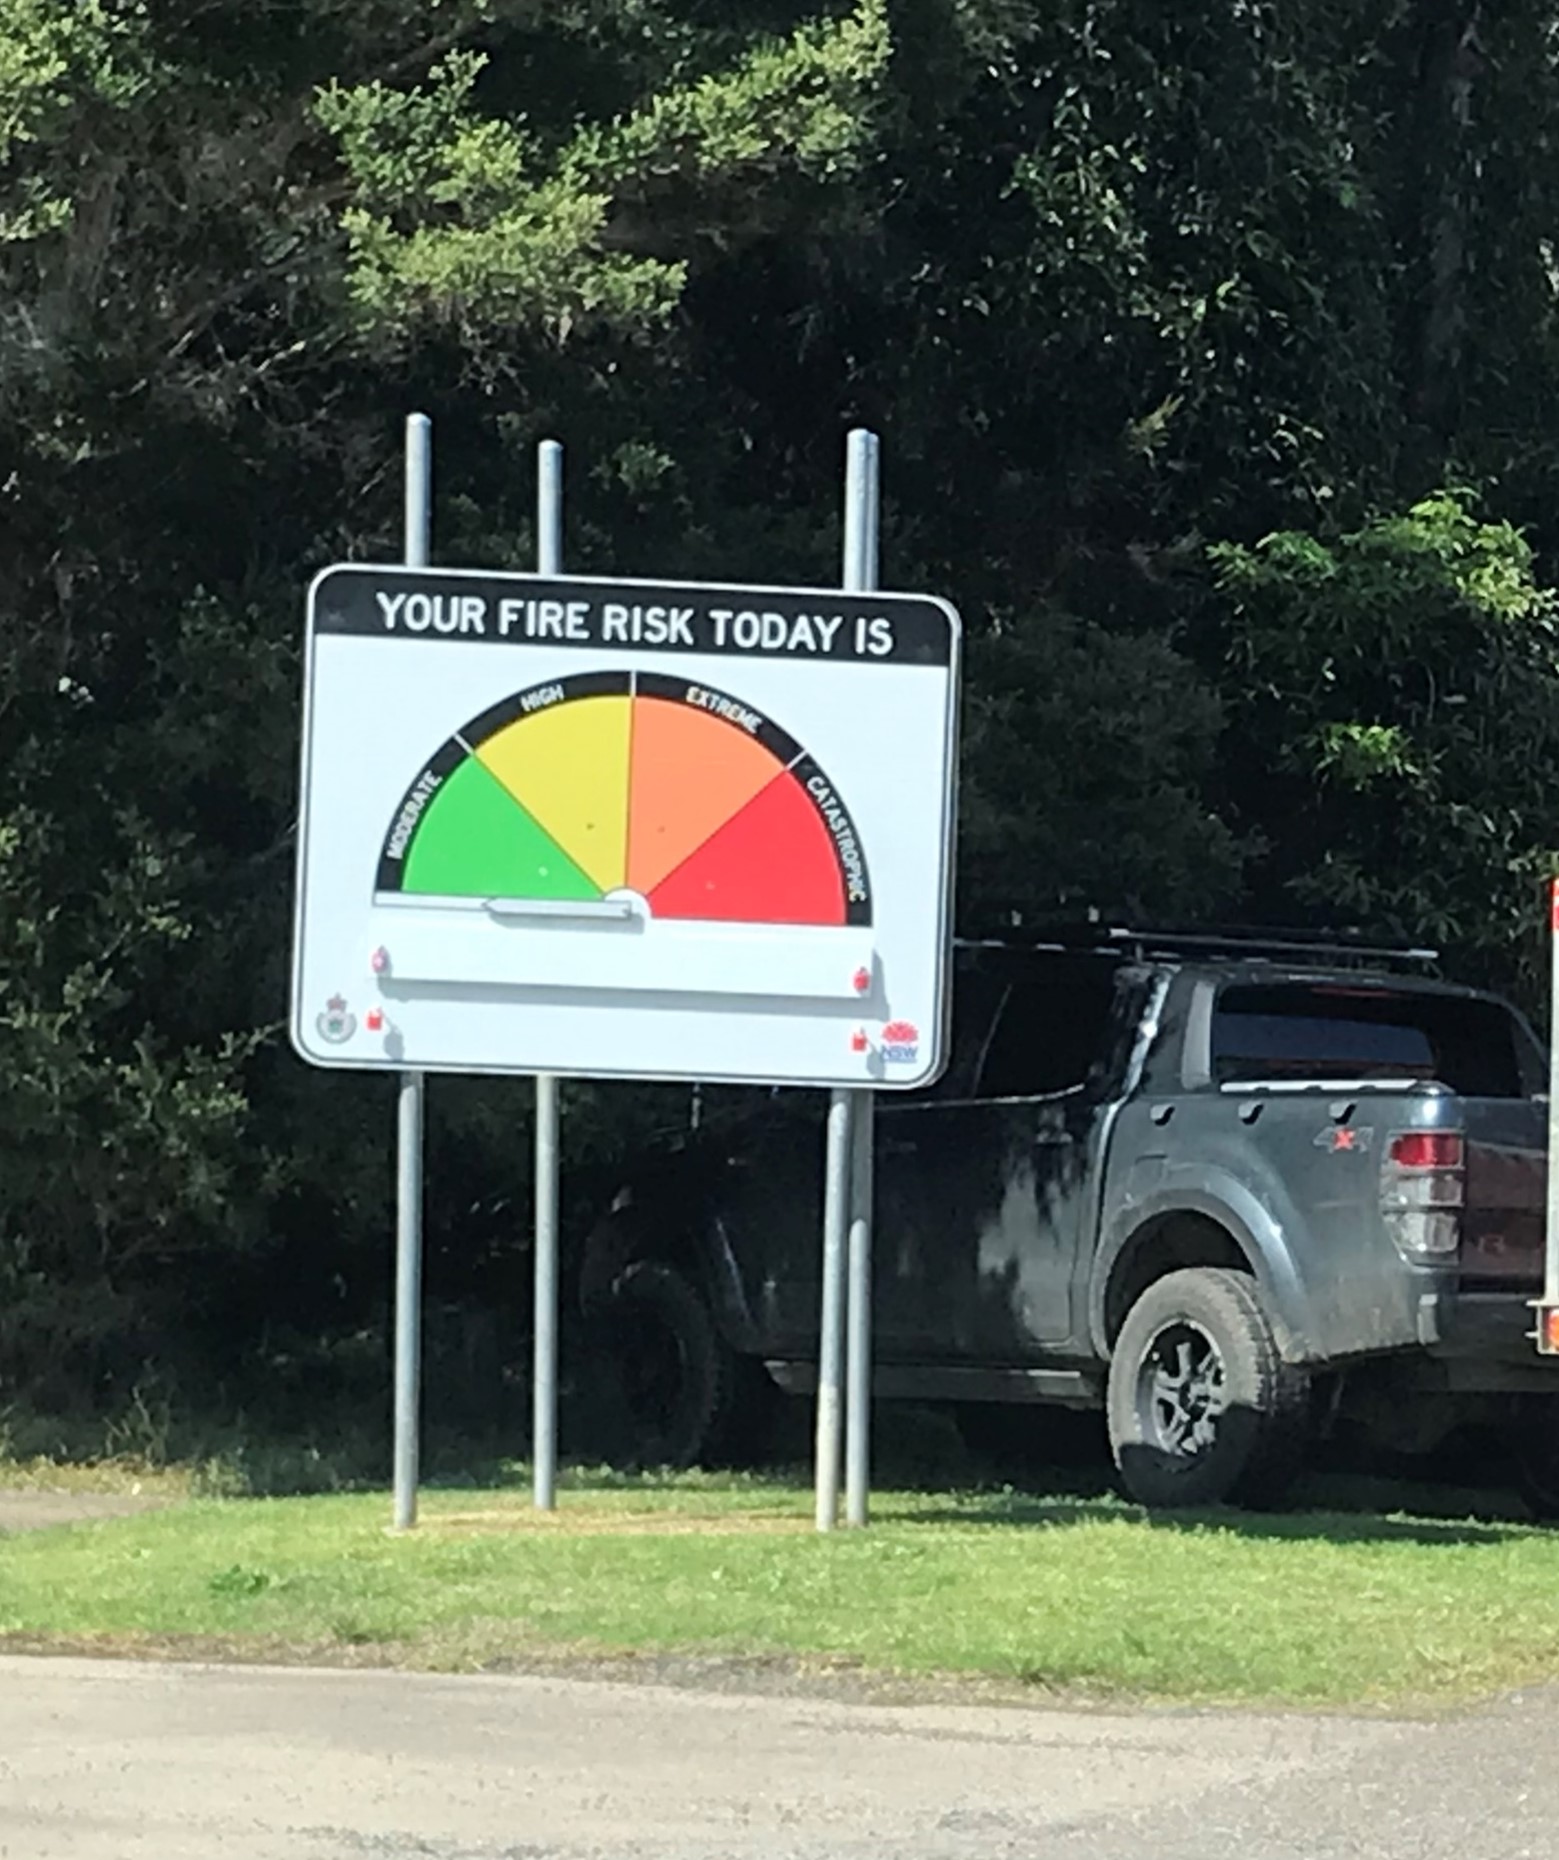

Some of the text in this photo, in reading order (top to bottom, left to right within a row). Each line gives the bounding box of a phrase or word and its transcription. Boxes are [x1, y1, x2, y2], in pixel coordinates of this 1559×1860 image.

[375, 591, 894, 655] YOUR FIRE RISK TODAY IS
[520, 684, 565, 712] HIGH
[685, 686, 764, 734] EXTREME
[386, 769, 443, 860] MODERATE
[806, 776, 867, 903] CATASTROPHIC
[880, 1044, 919, 1059] NSW
